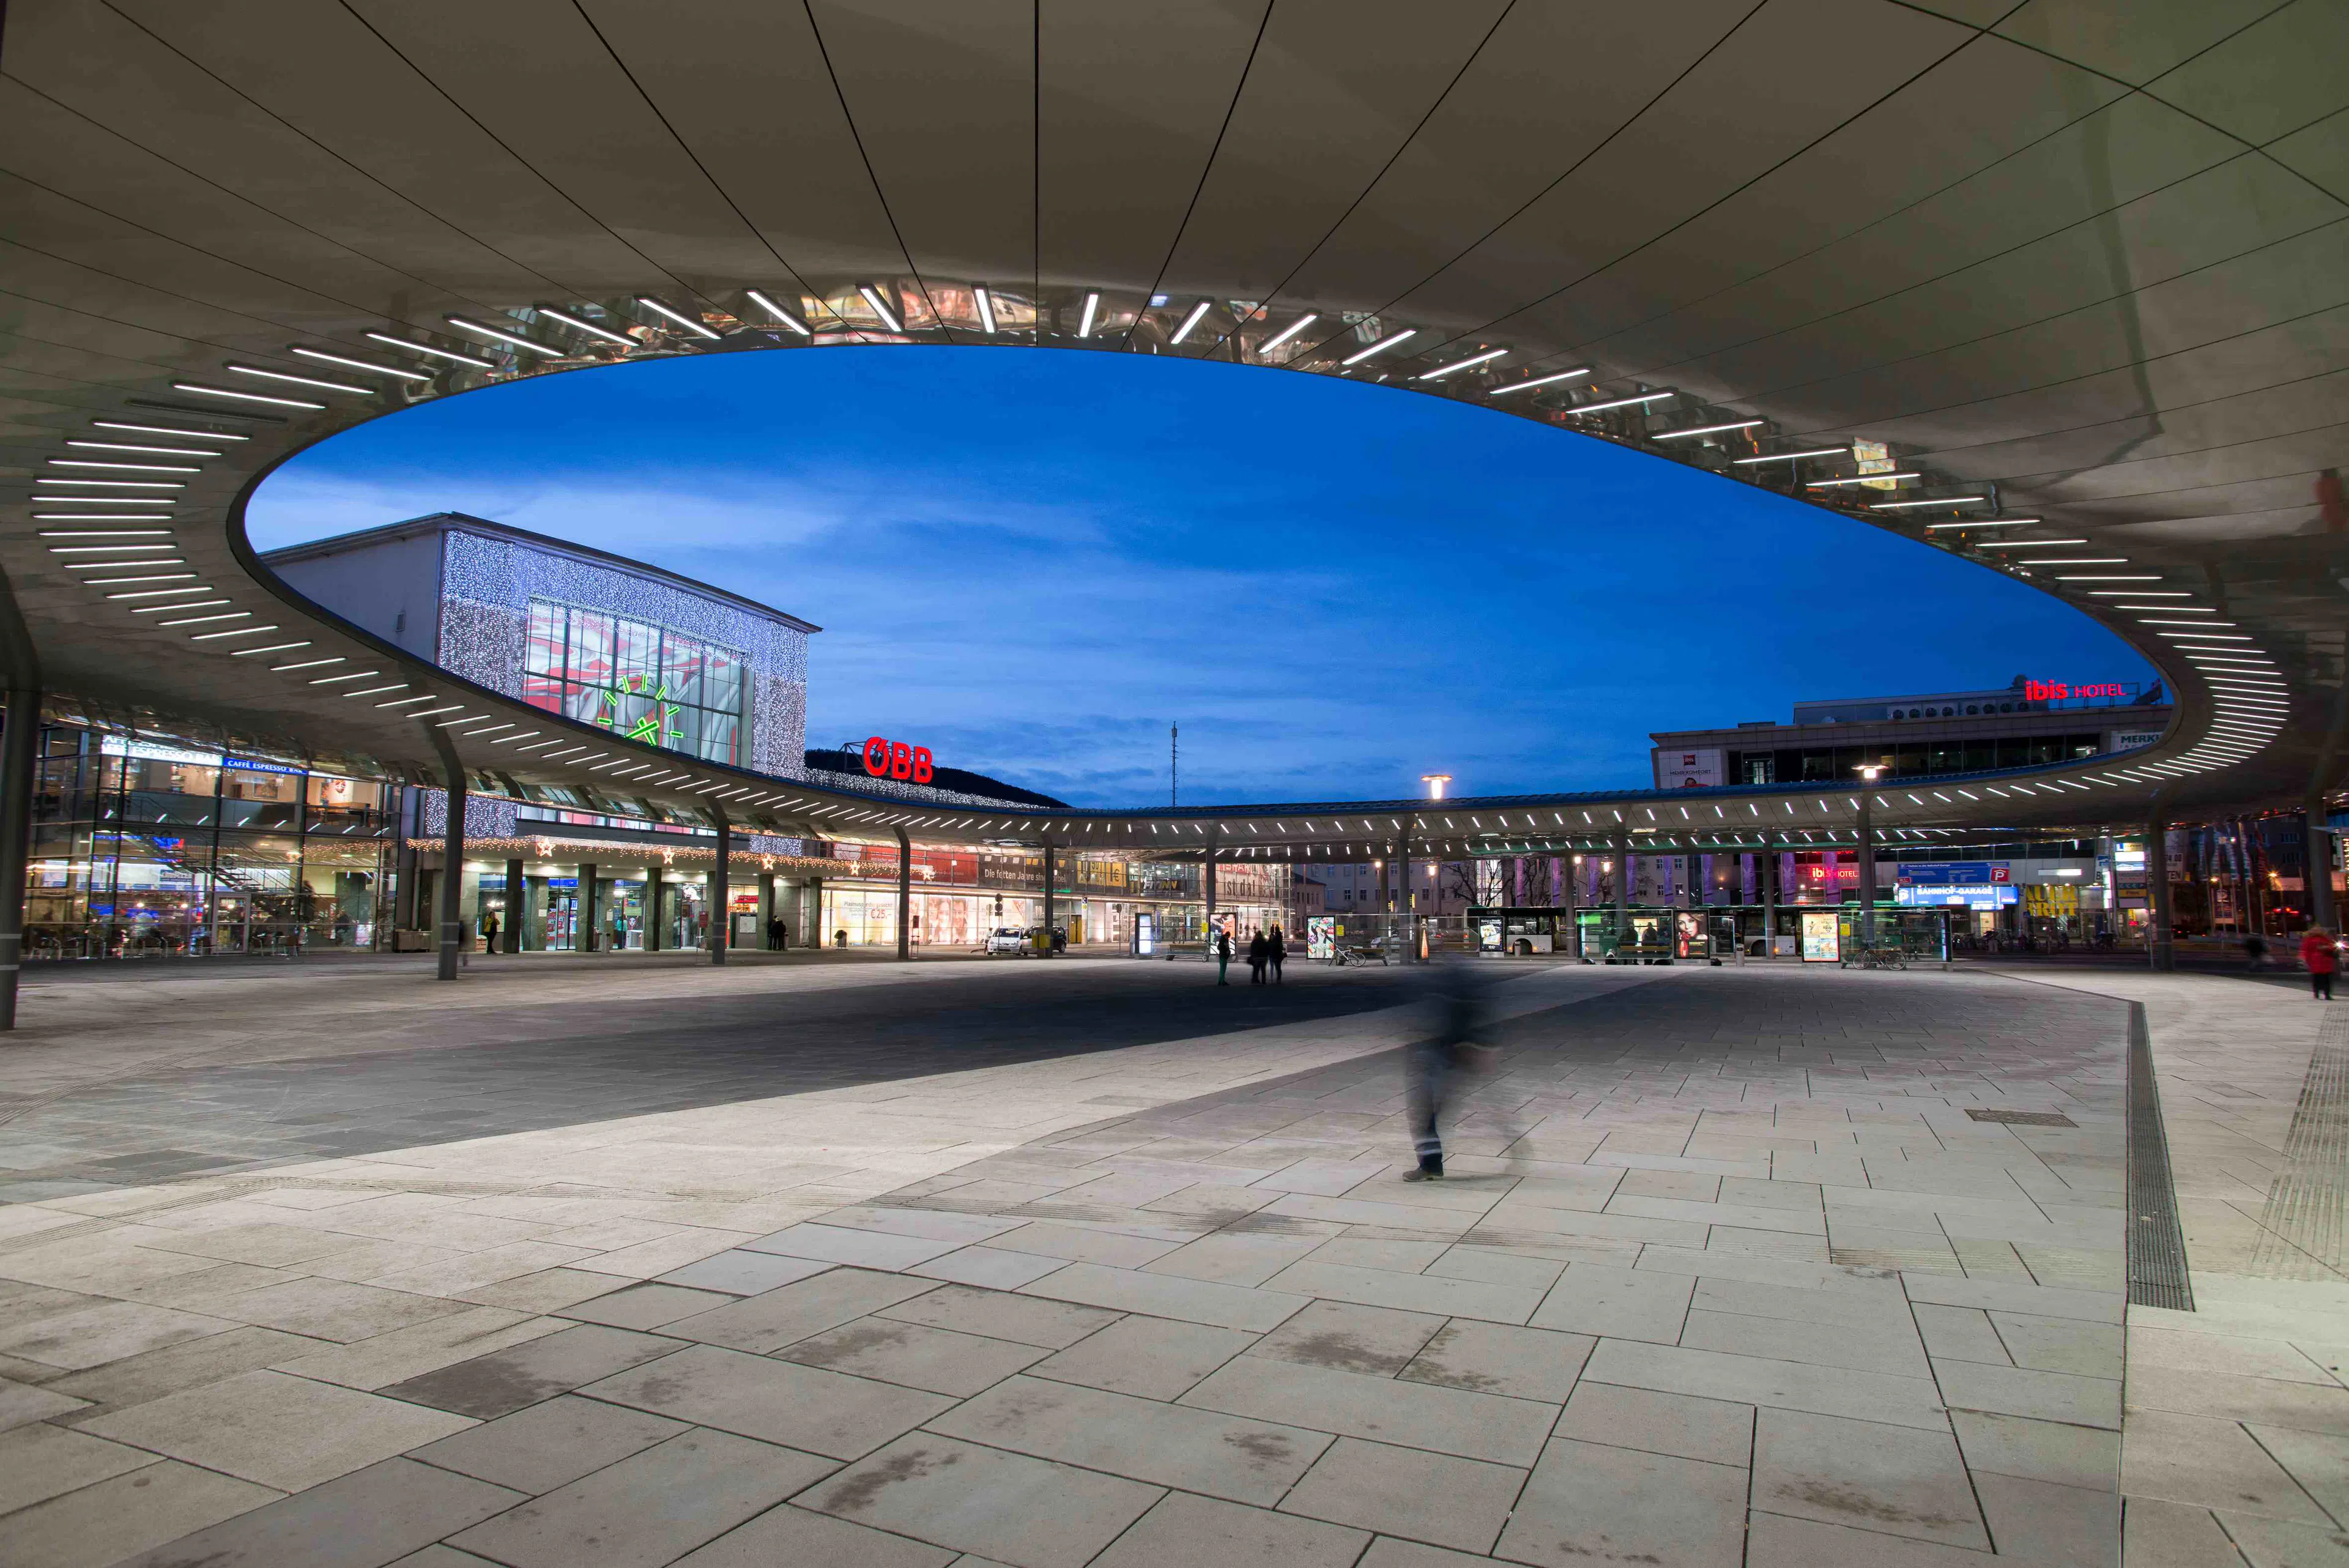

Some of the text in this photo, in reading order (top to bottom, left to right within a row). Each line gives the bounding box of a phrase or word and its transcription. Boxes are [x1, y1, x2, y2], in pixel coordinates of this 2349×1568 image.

[2025, 679, 2127, 700] ibis HOTEL
[985, 869, 995, 878] Die
[996, 870, 1016, 880] fetten
[1017, 871, 1034, 880] Jahre
